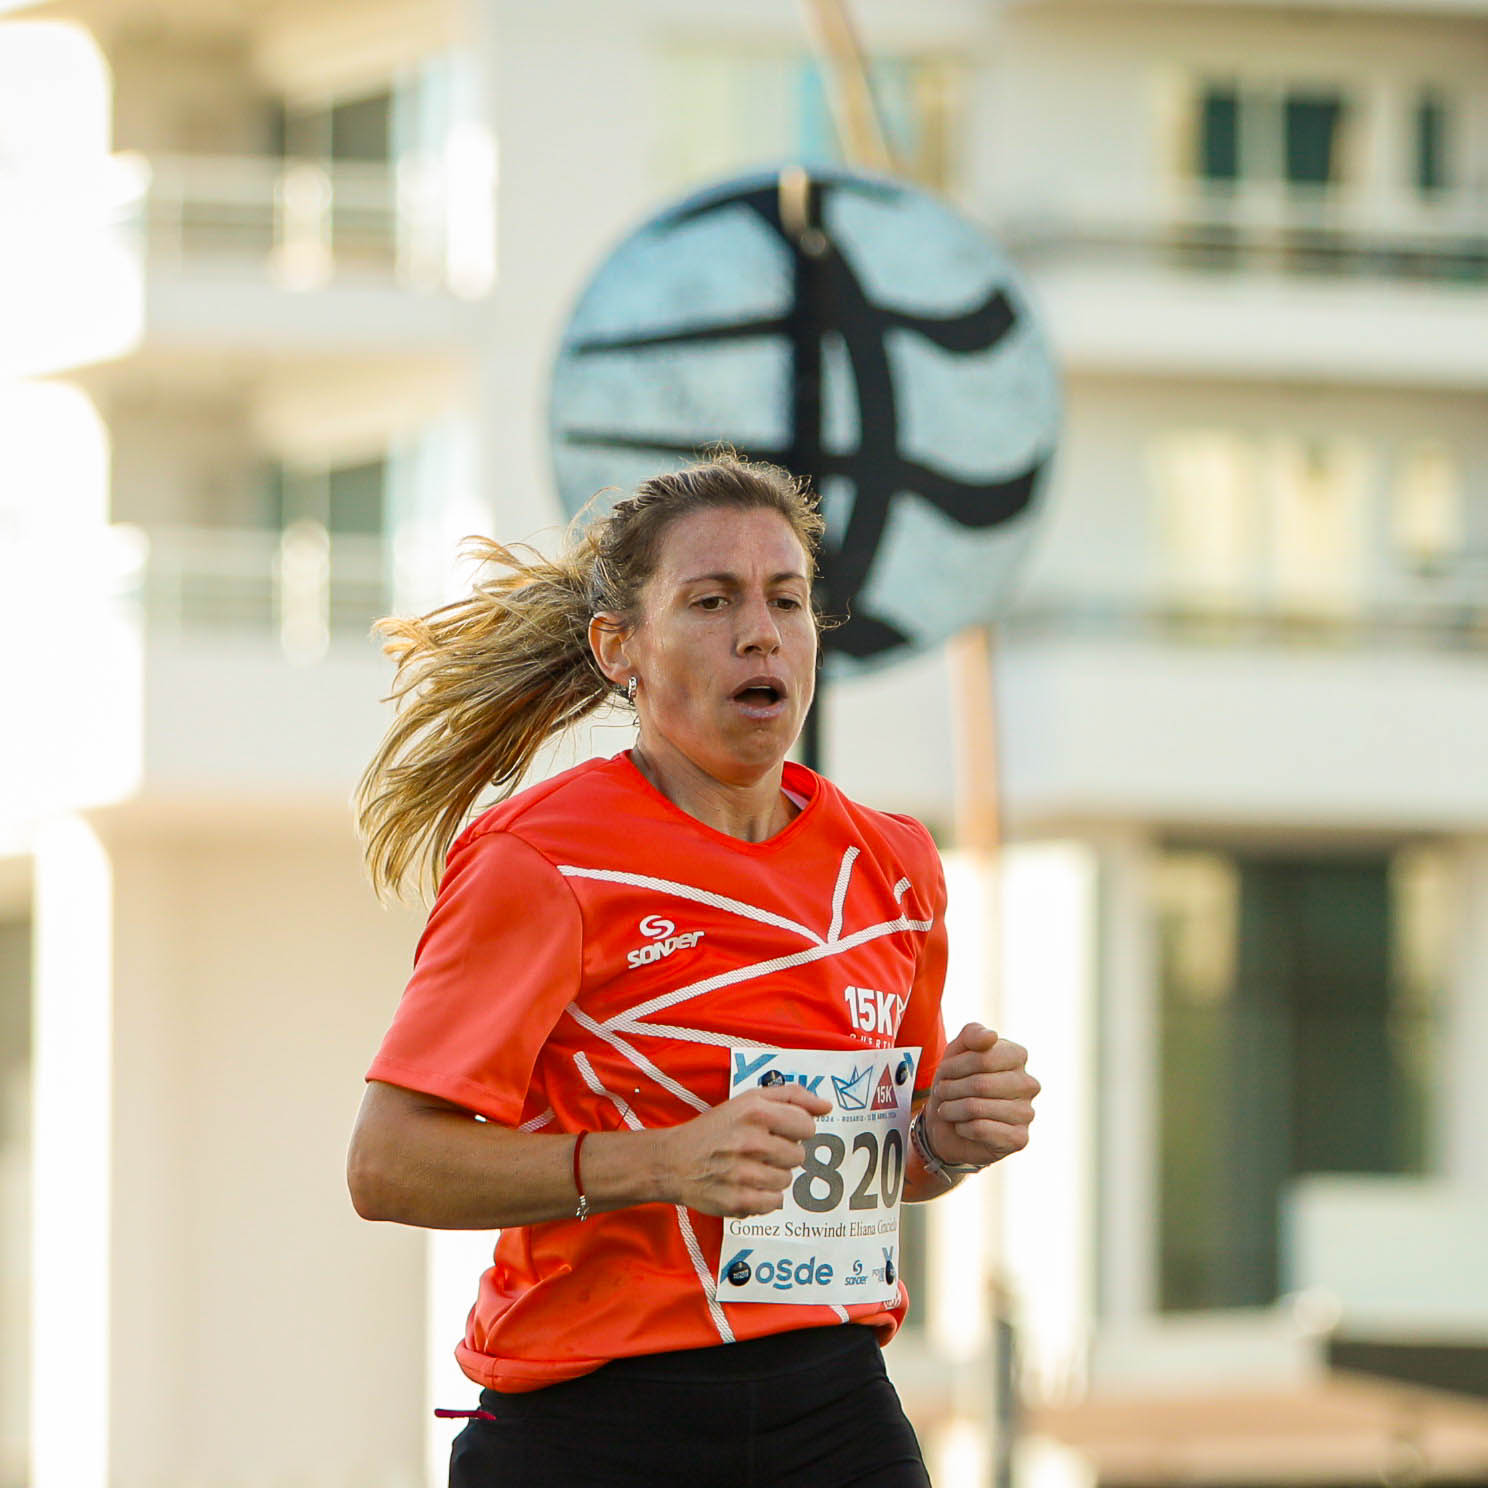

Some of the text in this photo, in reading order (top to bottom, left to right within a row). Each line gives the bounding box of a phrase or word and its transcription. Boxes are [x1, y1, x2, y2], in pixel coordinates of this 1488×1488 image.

[844, 985, 897, 1037] 15K
[876, 1085, 892, 1104] 15K
[776, 1129, 903, 1212] 820
[729, 1220, 780, 1236] Gomez
[784, 1222, 846, 1238] Schwindt
[849, 1221, 876, 1237] Eliana
[755, 1256, 834, 1289] osde
